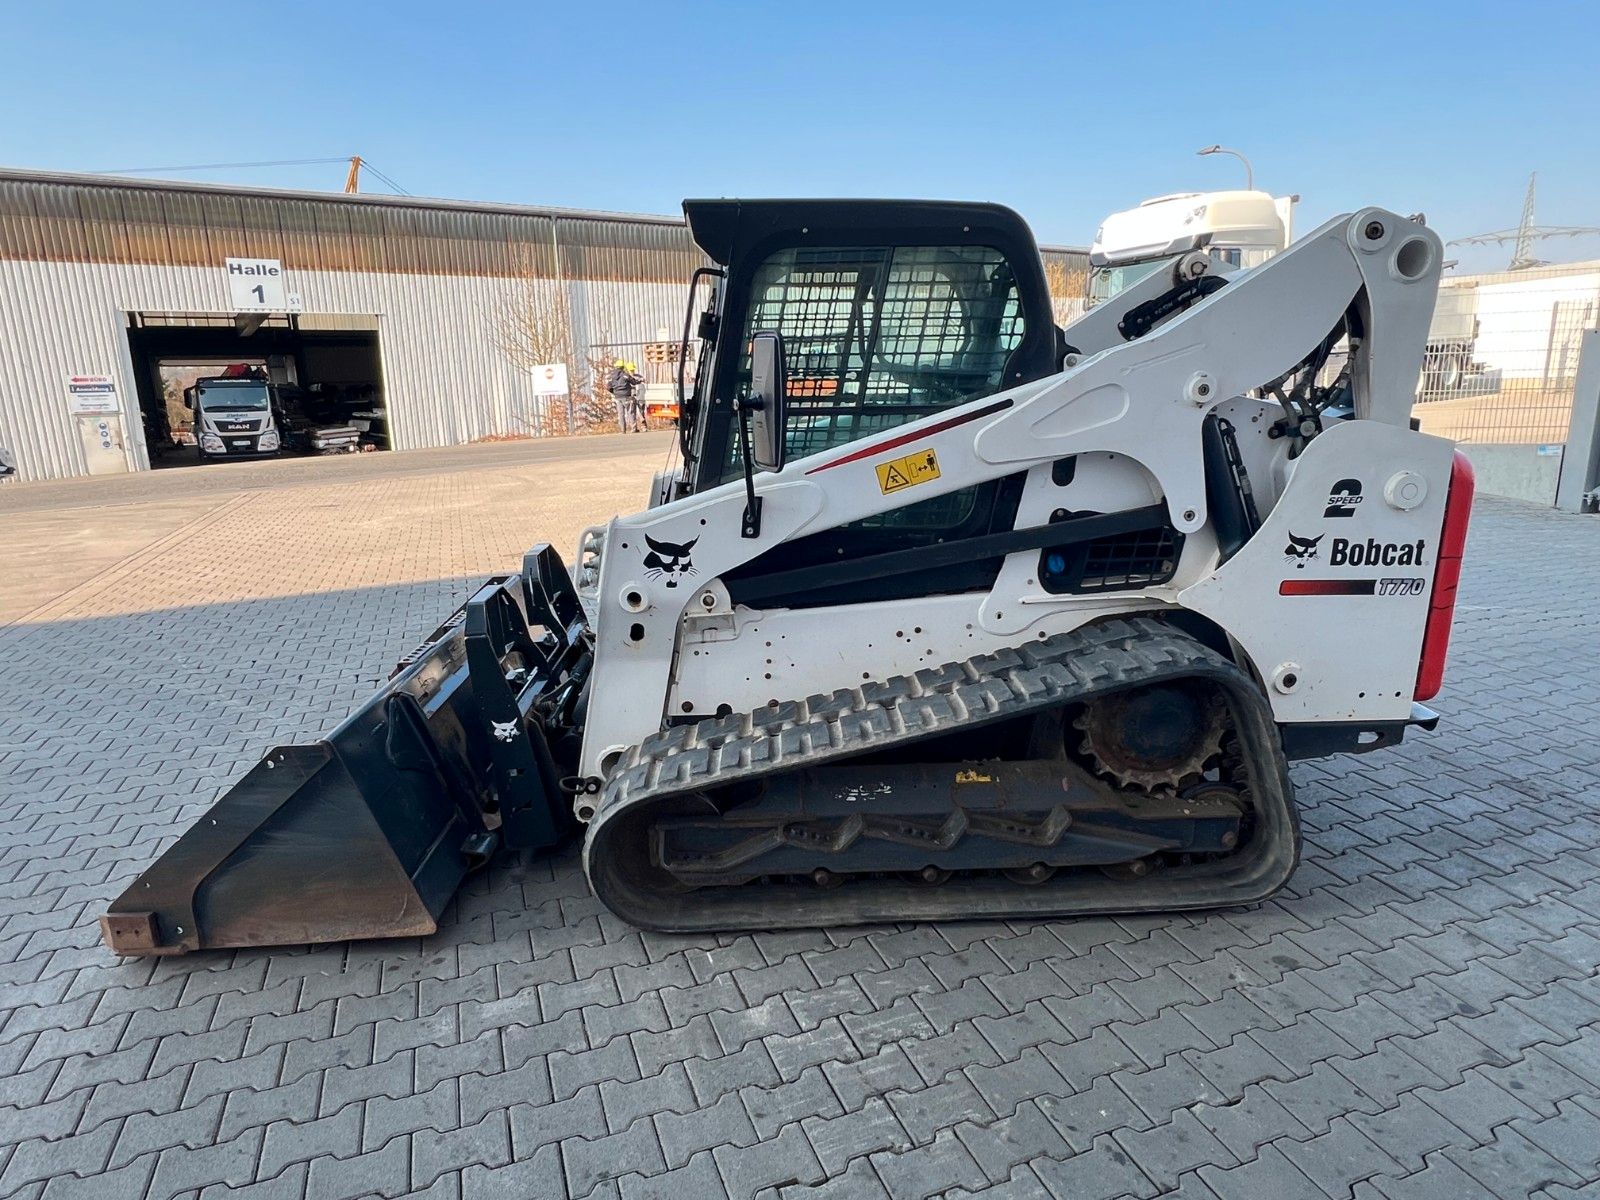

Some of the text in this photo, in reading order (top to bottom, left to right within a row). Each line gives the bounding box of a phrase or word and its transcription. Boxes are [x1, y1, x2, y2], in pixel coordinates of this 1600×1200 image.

[229, 263, 280, 277] Halle
[251, 284, 265, 304] 1
[1323, 478, 1363, 518] 2
[1327, 495, 1364, 505] SPEED
[1329, 538, 1426, 567] Bobcat
[1378, 577, 1426, 596] T770
